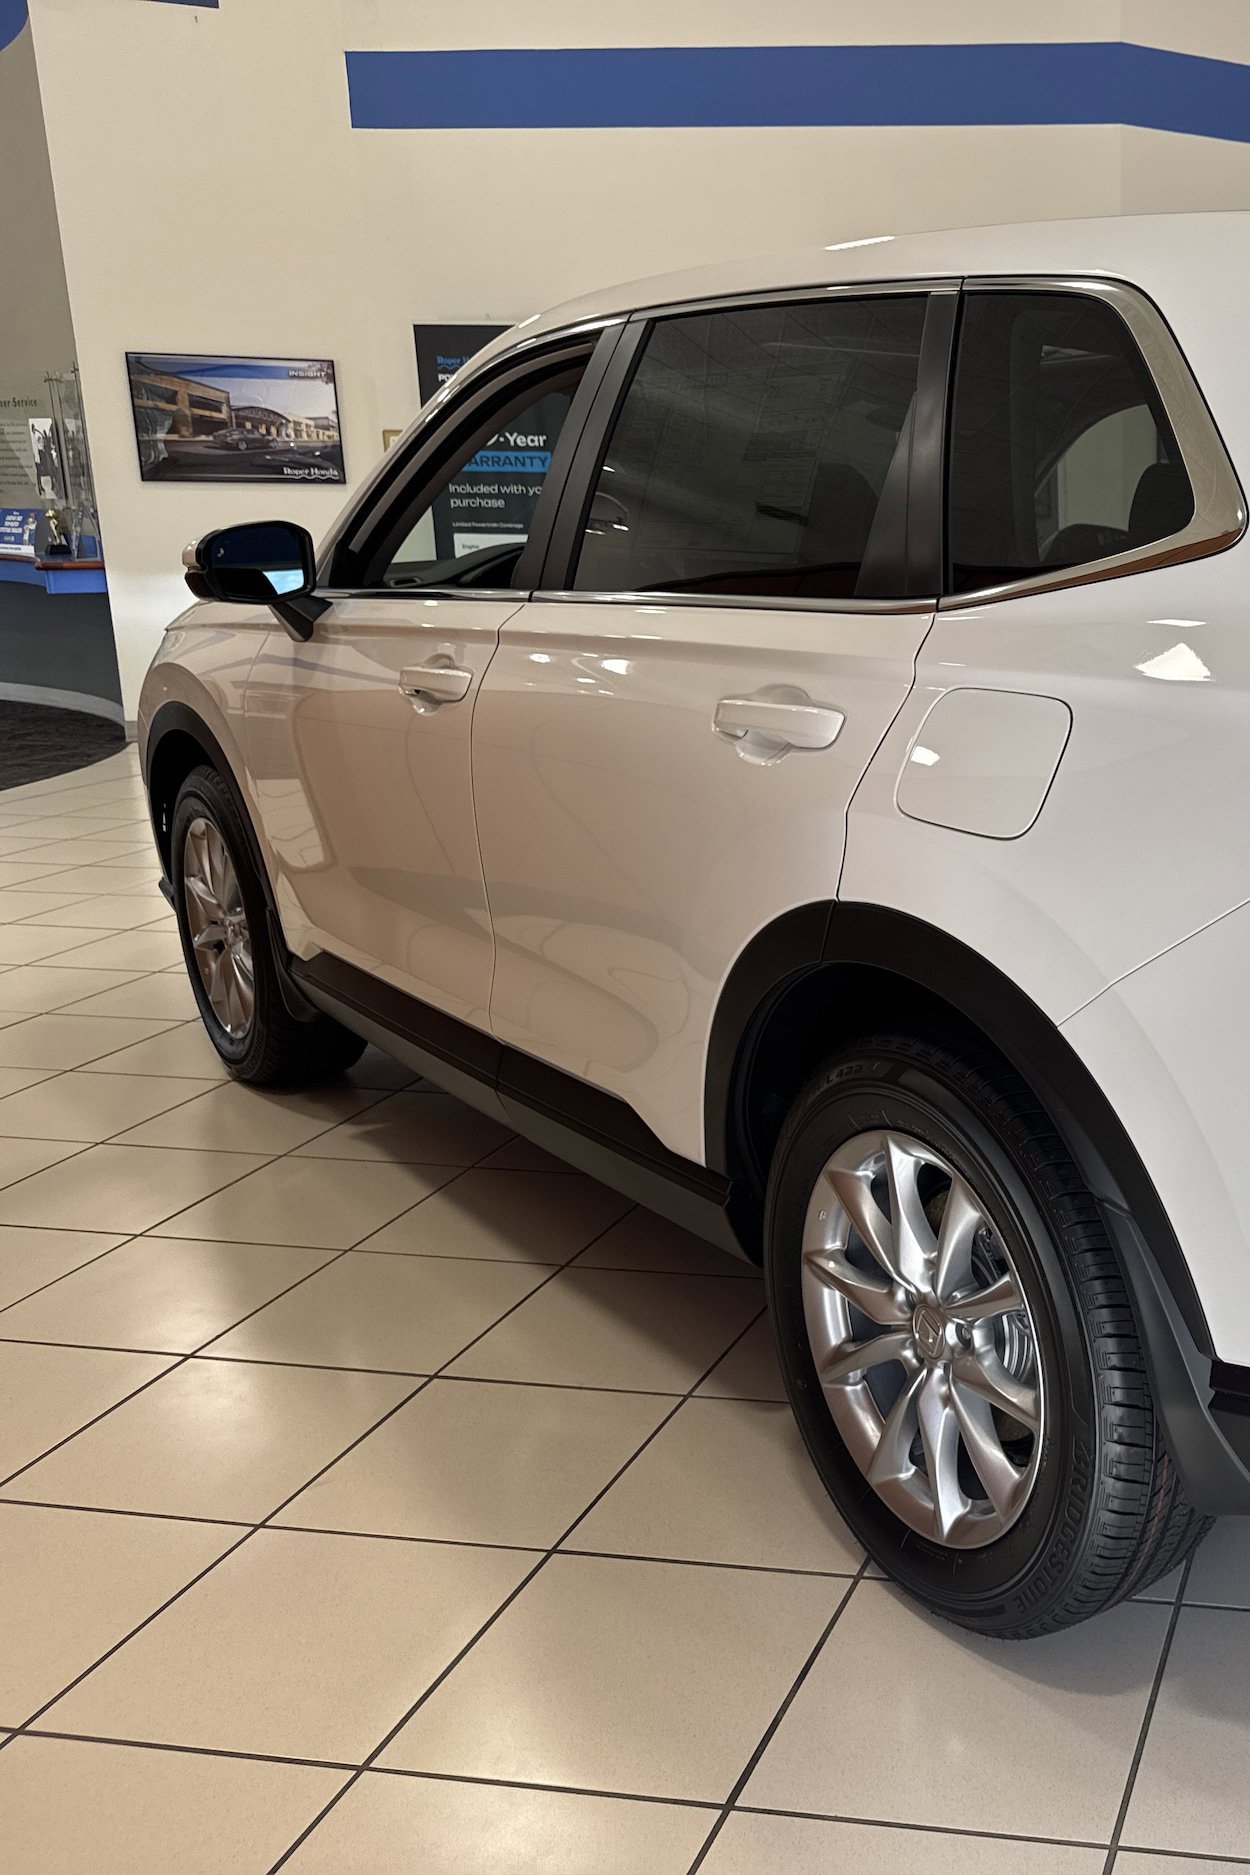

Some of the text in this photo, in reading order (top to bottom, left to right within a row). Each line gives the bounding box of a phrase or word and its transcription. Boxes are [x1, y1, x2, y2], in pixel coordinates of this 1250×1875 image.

[288, 370, 327, 378] INSIGHT
[12, 396, 38, 408] Service
[468, 456, 549, 468] ARRANTY
[283, 466, 309, 476] Roper
[448, 483, 543, 497] Included with yo
[449, 497, 505, 509] purchase
